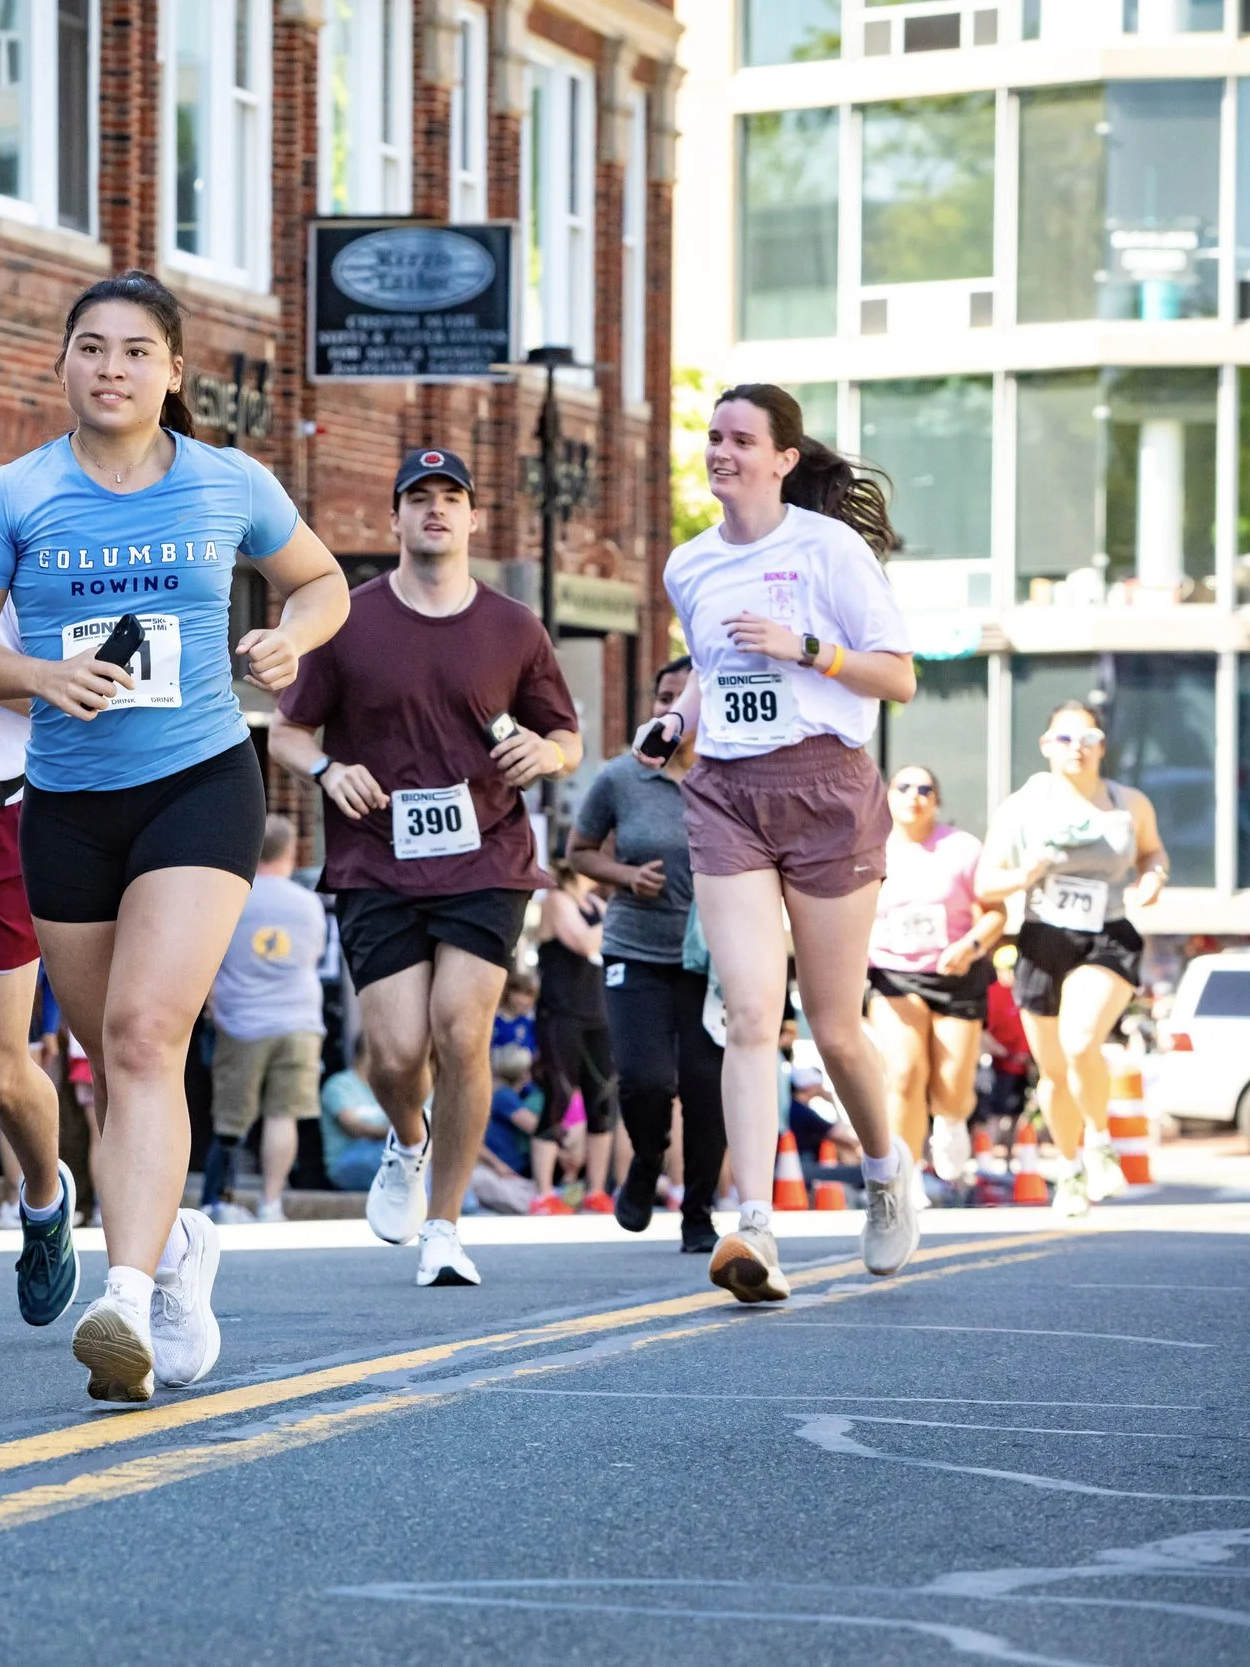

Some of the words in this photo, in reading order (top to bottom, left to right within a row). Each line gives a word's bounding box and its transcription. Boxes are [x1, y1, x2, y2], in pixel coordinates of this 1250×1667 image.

[38, 541, 219, 569] COLUMBIA
[71, 575, 179, 596] ROWING
[718, 674, 771, 685] BIONIC
[725, 690, 777, 723] 389
[401, 790, 455, 802] BIONIC
[407, 805, 462, 836] 390
